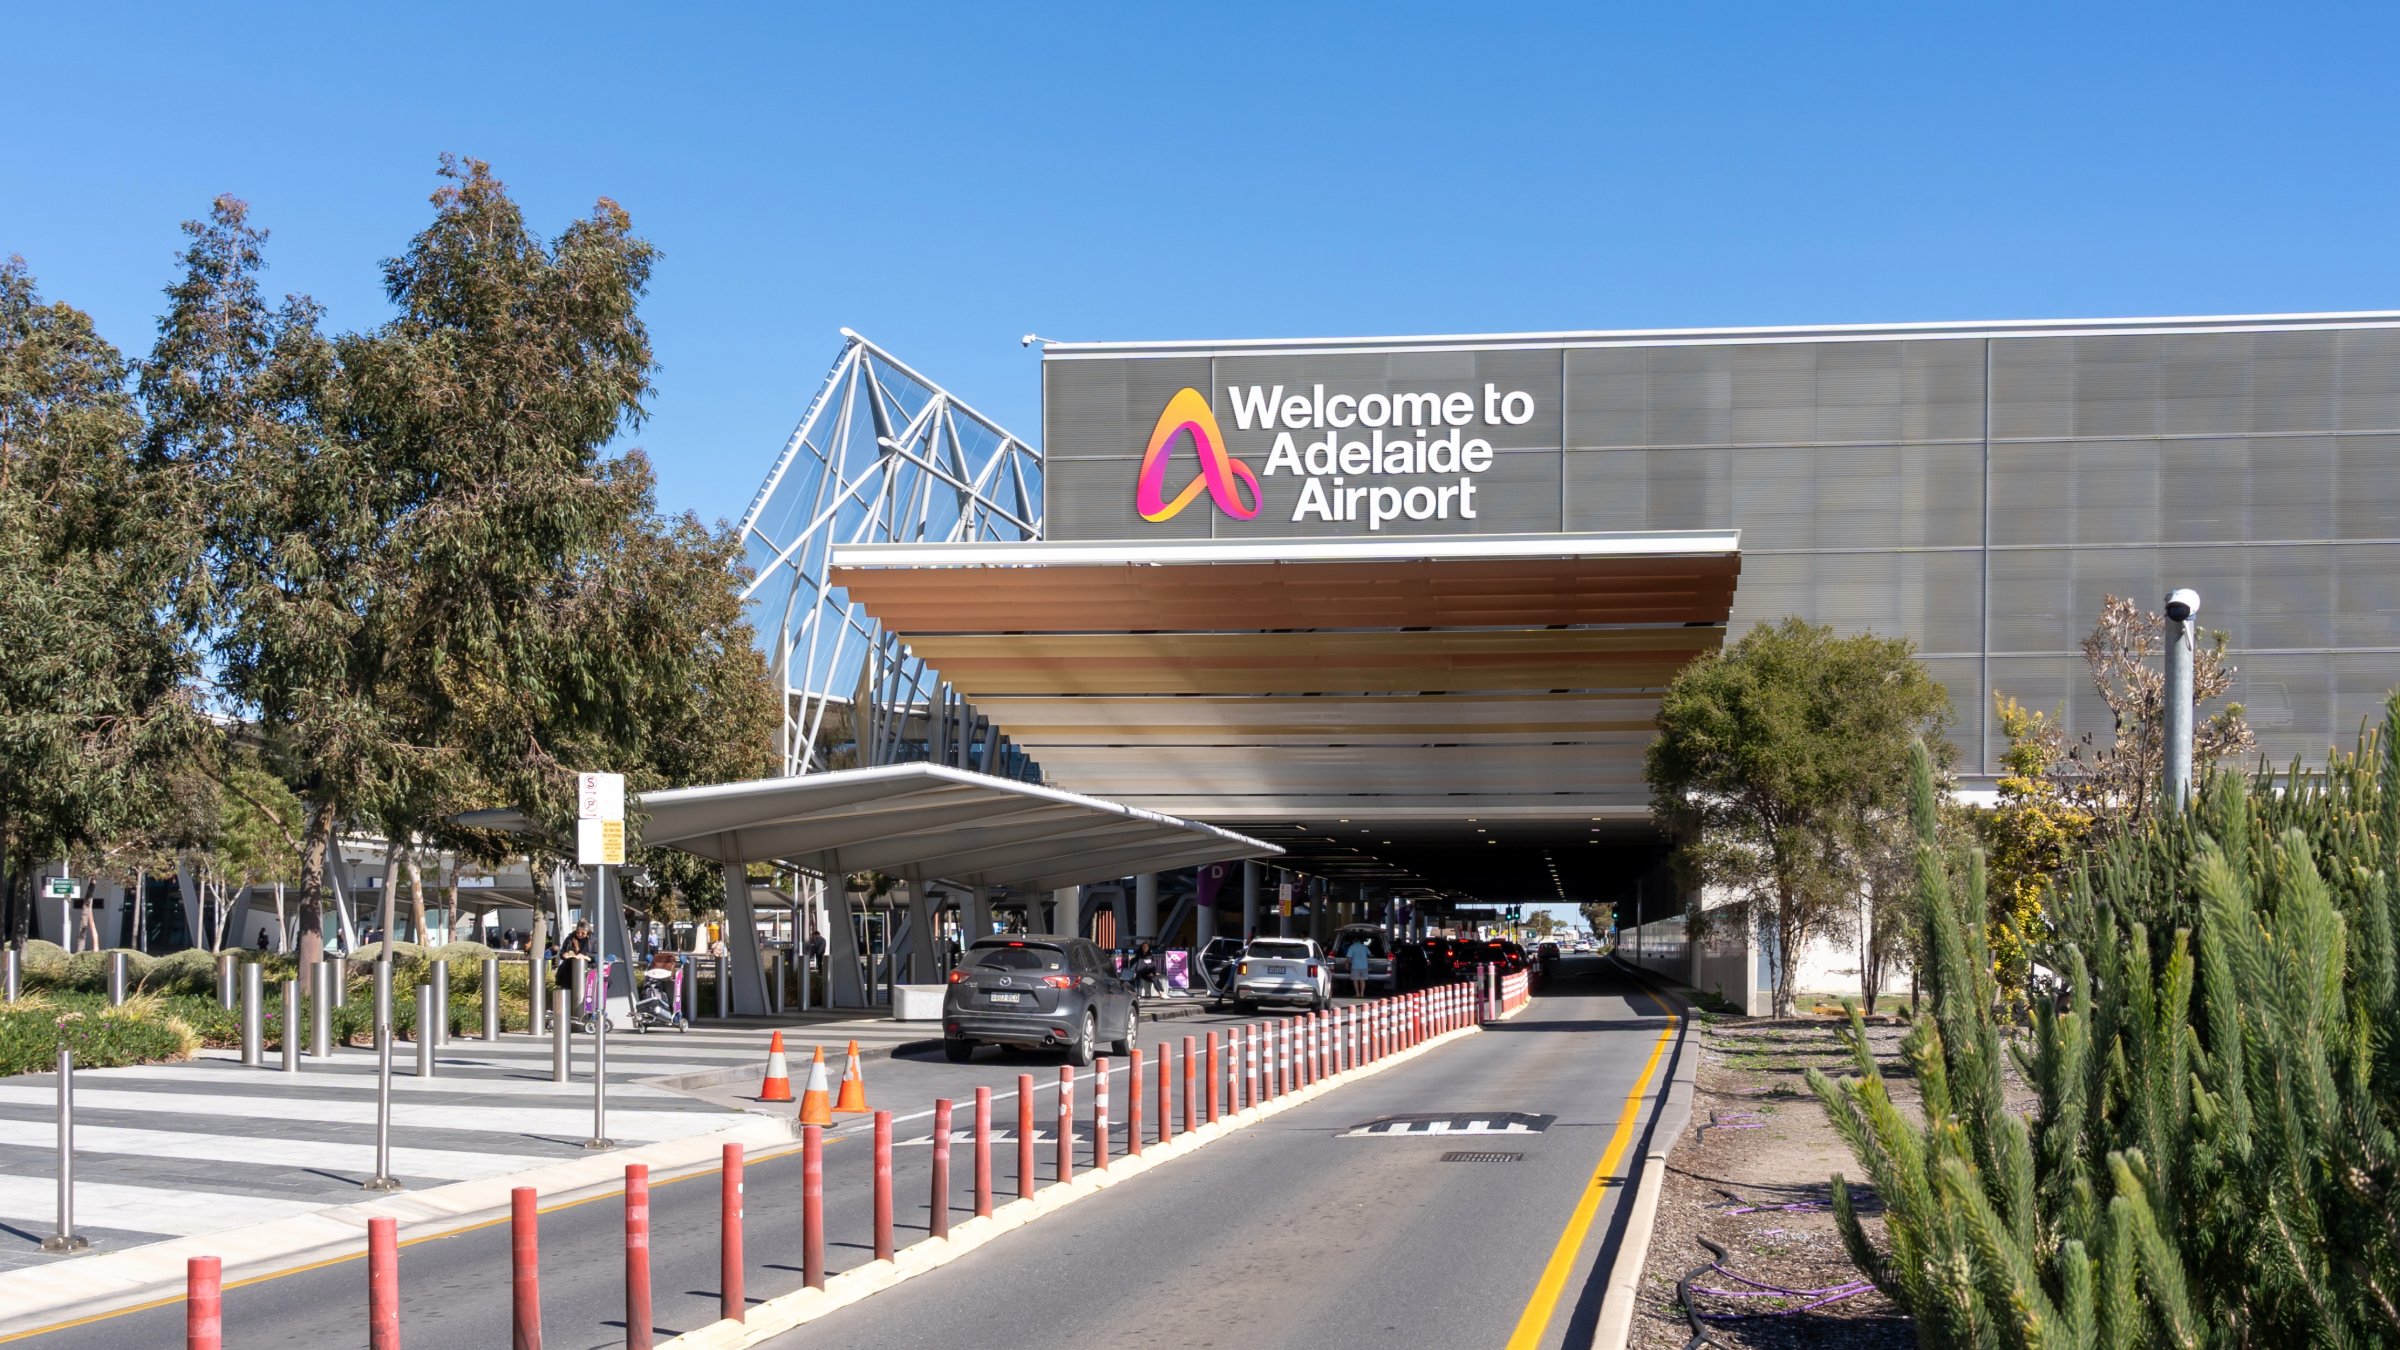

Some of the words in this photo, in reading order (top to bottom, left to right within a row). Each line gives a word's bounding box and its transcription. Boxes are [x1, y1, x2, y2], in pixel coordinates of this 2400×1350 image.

[1228, 383, 1474, 430] Welcome
[1484, 383, 1535, 426] to
[1262, 429, 1494, 476] Adelaide
[1291, 477, 1477, 529] Airport
[1211, 865, 1223, 879] D
